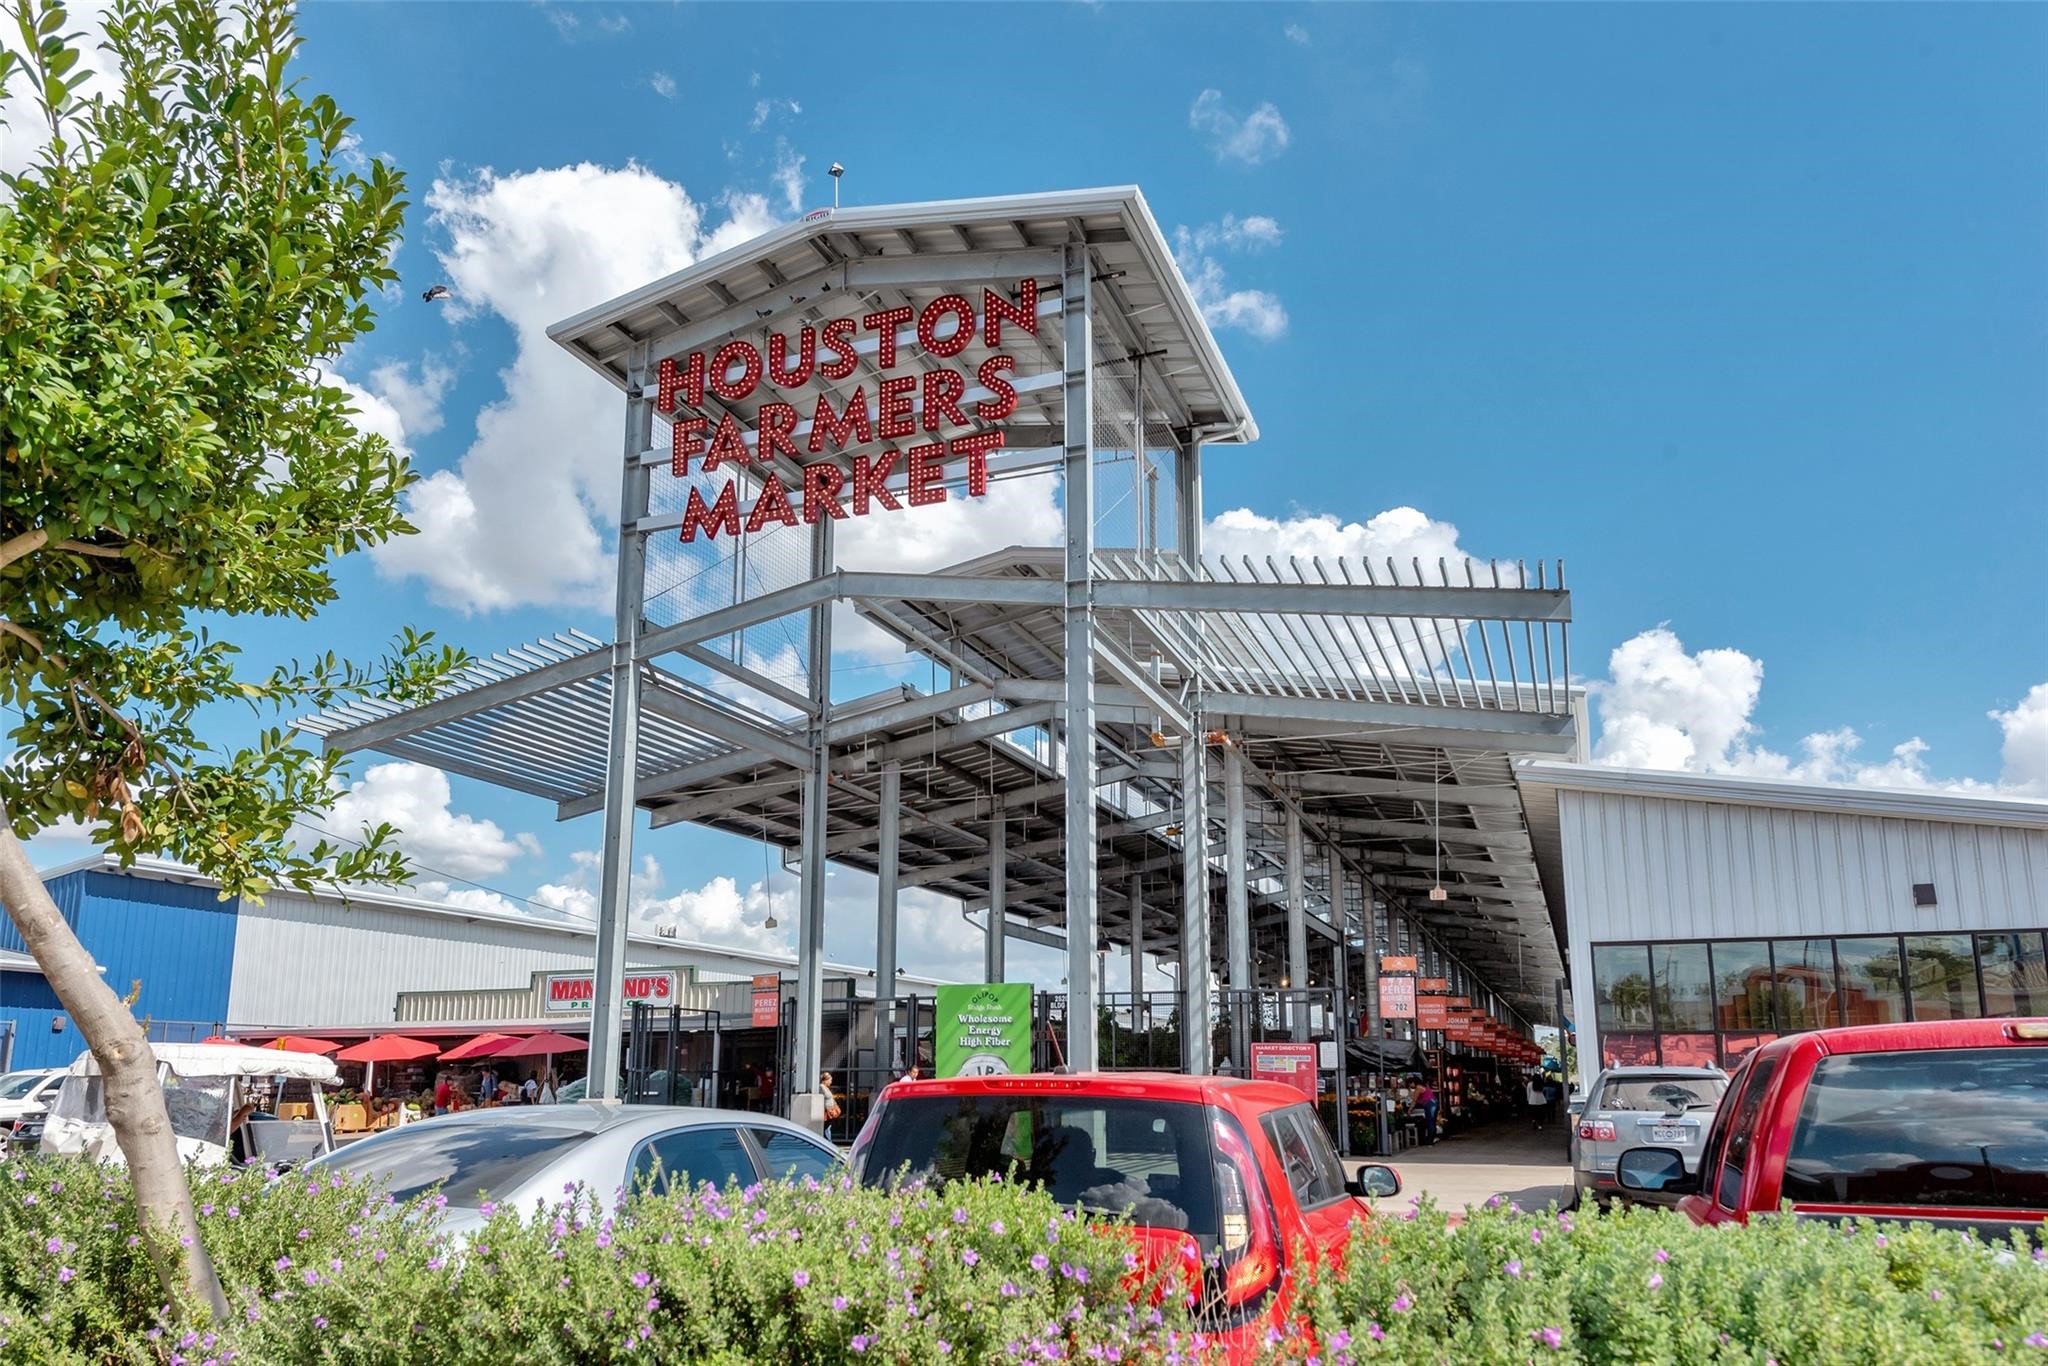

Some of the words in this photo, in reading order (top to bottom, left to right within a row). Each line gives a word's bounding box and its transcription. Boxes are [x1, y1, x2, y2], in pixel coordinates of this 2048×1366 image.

[658, 278, 1038, 414] HOUSTON
[672, 355, 1018, 478] FARMERS
[679, 431, 1005, 543] MARKET
[551, 976, 670, 1000] MANNO'S
[958, 1014, 1014, 1023] Wholesome
[968, 1025, 1002, 1036] Energy
[960, 1038, 982, 1048] High
[985, 1037, 1011, 1046] Fiber
